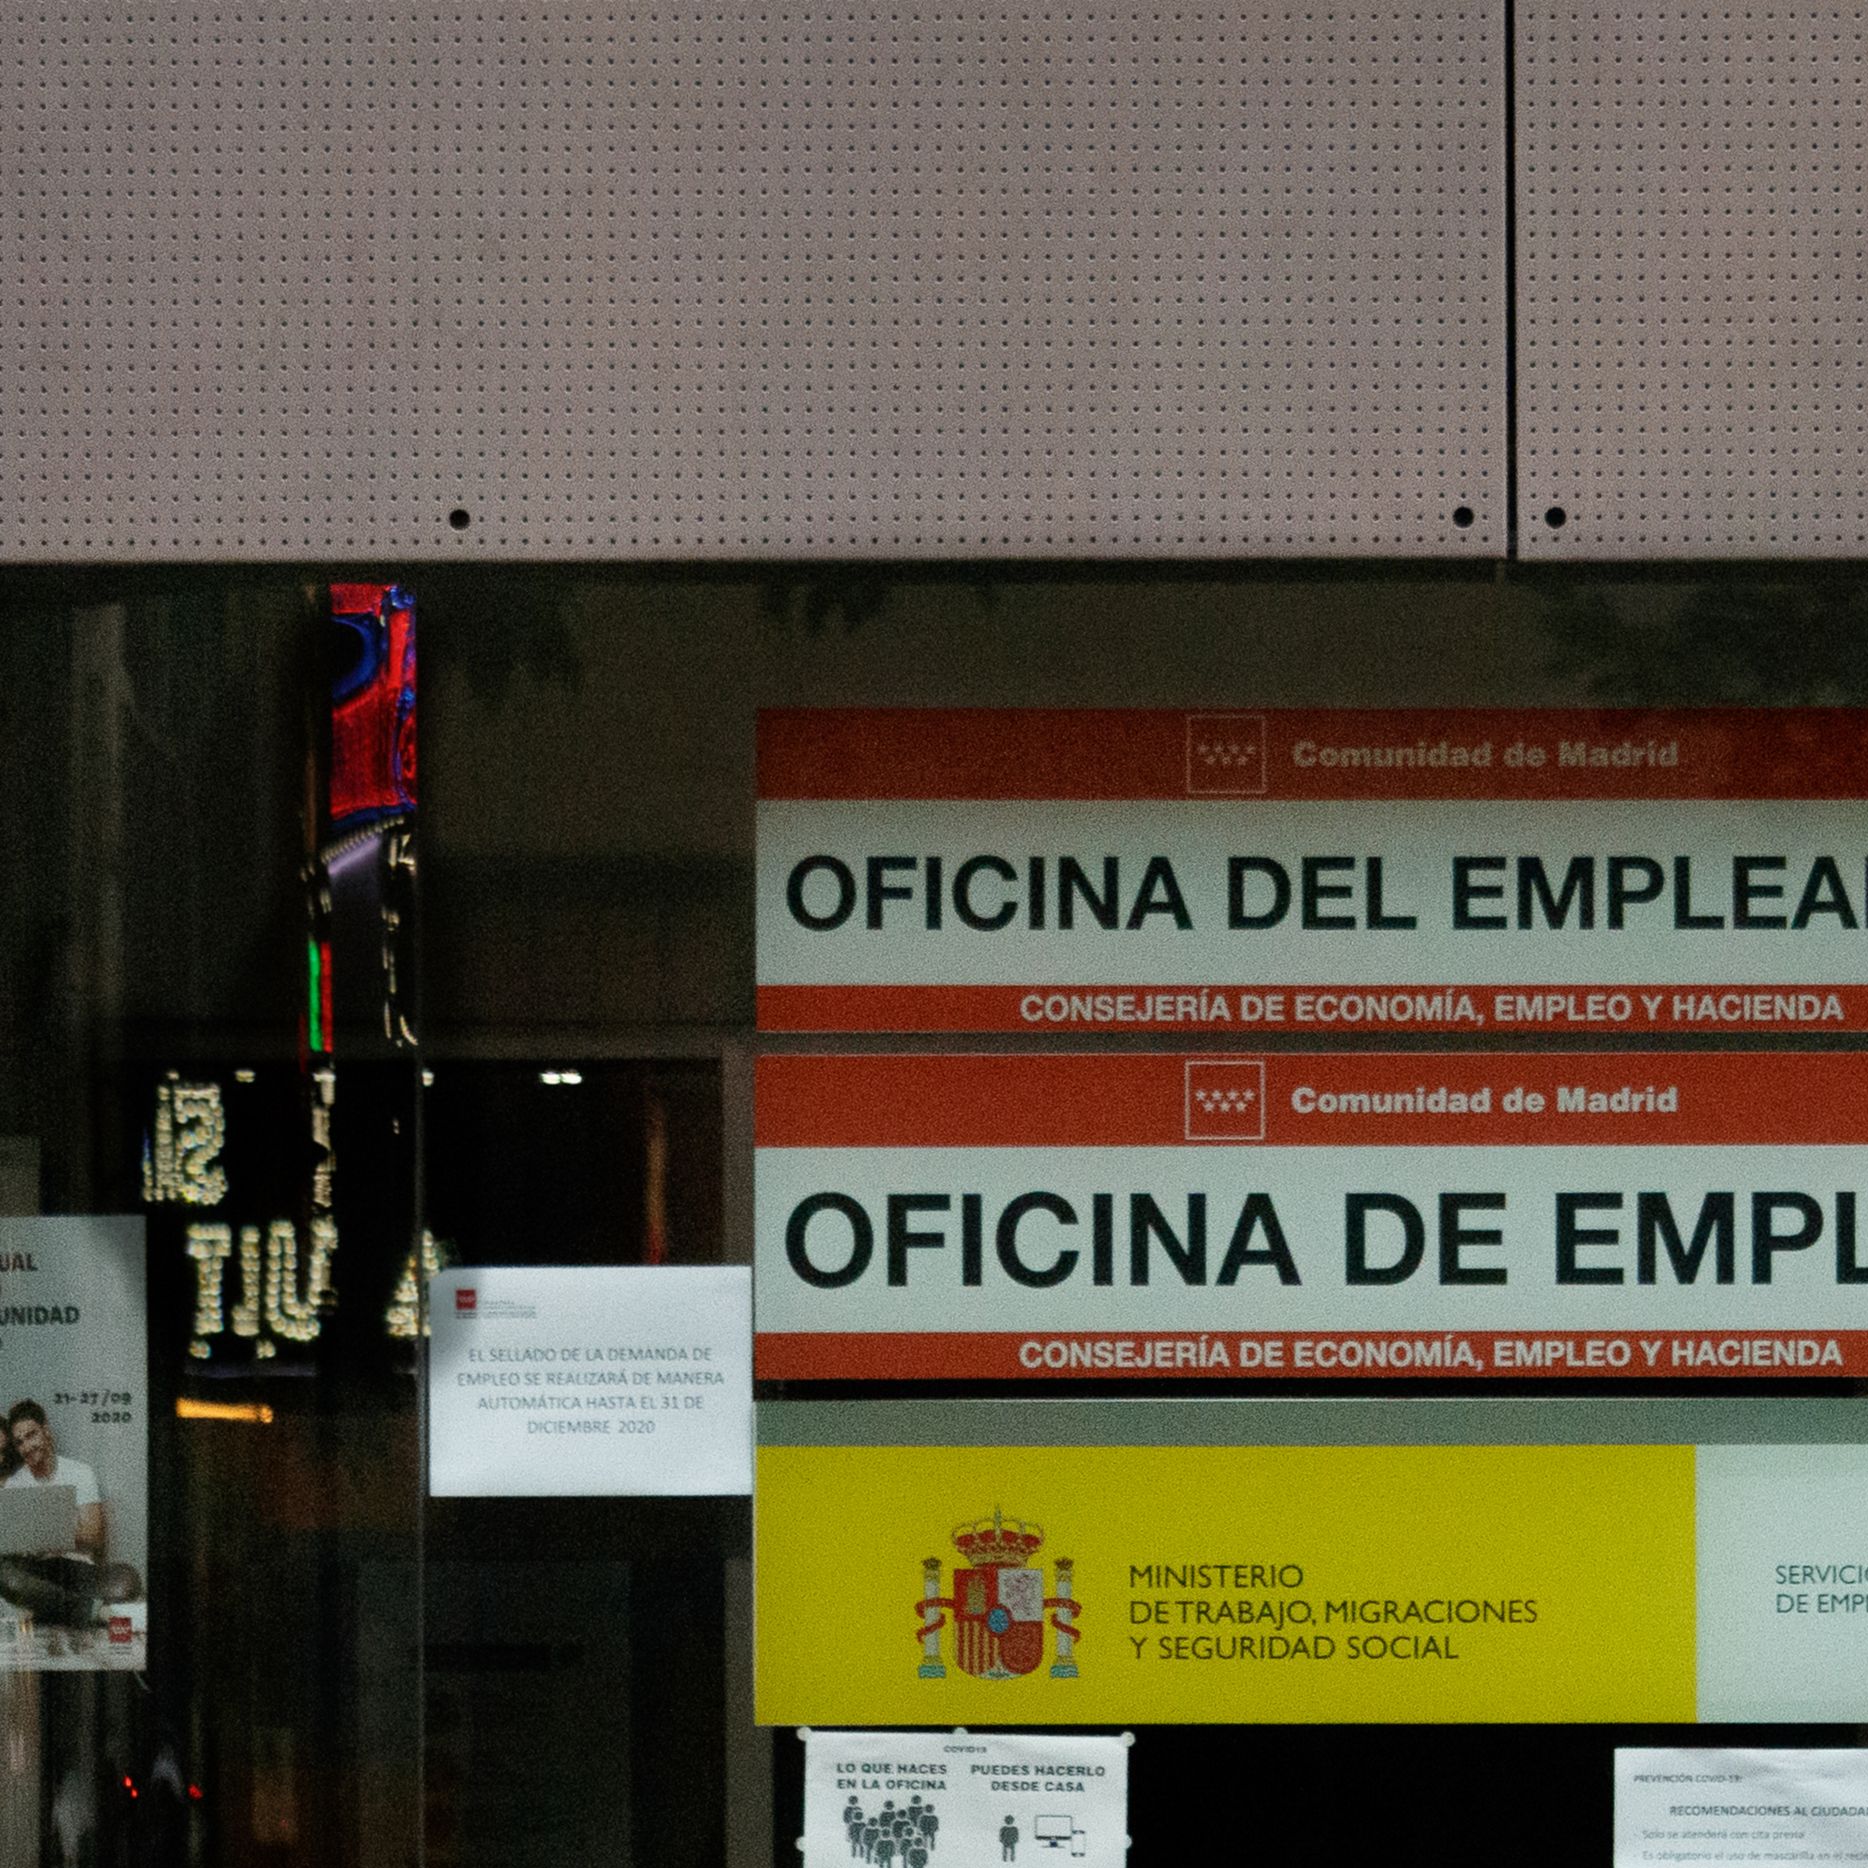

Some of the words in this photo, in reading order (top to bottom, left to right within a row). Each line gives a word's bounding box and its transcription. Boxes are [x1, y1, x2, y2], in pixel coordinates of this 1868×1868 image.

[1292, 741, 1492, 767] Comunidad
[1504, 741, 1546, 767] de
[1558, 741, 1679, 767] Madrid
[786, 855, 1190, 929] OFICINA
[1228, 856, 1414, 928] DEL
[1020, 994, 1231, 1021] CONSEJERÍA
[1241, 995, 1284, 1021] DE
[1295, 991, 1484, 1021] ECONOMÍA,
[1495, 994, 1632, 1021] EMPLEO
[1642, 995, 1662, 1020] Y
[1673, 994, 1843, 1021] HACIENDA
[1291, 1087, 1491, 1113] Comunidad
[1502, 1087, 1545, 1113] de
[1557, 1086, 1678, 1112] Madrid
[786, 1193, 1297, 1287] OFICINA
[1346, 1193, 1505, 1284] DE
[467, 1348, 483, 1361] EL
[489, 1349, 557, 1361] SELLADO
[560, 1348, 580, 1361] DE
[585, 1349, 604, 1361] LA
[607, 1348, 688, 1360] DEMANDA
[692, 1348, 711, 1360] DE
[1019, 1340, 1230, 1368] CONSEJERÍA
[1239, 1340, 1283, 1367] DE
[1294, 1340, 1483, 1368] ECONOMÍA,
[1493, 1339, 1631, 1367] EMPLEO
[1640, 1340, 1662, 1366] Y
[1671, 1339, 1843, 1366] HACIENDA
[456, 1373, 521, 1385] EMPLEO
[524, 1373, 540, 1385] SE
[546, 1372, 628, 1385] REALIZARÁ
[632, 1372, 651, 1385] DE
[656, 1372, 725, 1384] MANERA
[478, 1397, 582, 1408] AUTOMÁTICA
[586, 1396, 636, 1409] HASTA
[640, 1396, 656, 1409] EL
[661, 1396, 679, 1409] 31
[683, 1396, 703, 1409] DE
[90, 1412, 133, 1423] 2020
[527, 1421, 610, 1433] DICIEMBRE
[618, 1420, 656, 1433] 2020
[1130, 1564, 1303, 1588] MINISTERIO
[1777, 1594, 1807, 1613] DE
[1130, 1600, 1168, 1624] DE
[1176, 1600, 1316, 1630] TRABAJO,
[1325, 1600, 1537, 1623] MIGRACIONES
[1130, 1637, 1147, 1659] Y
[1159, 1636, 1336, 1660] SEGURIDAD
[1347, 1636, 1458, 1659] SOCIAL
[836, 1763, 857, 1773] LO
[860, 1763, 891, 1773] QUE
[897, 1764, 947, 1774] HACES
[970, 1765, 1030, 1775] PUEDES
[1034, 1766, 1105, 1776] HACERLO
[837, 1779, 857, 1789] EN
[861, 1780, 880, 1789] LA
[885, 1780, 946, 1789] OFICINA
[1633, 1775, 1693, 1783] PREVENCIÓN
[991, 1781, 1039, 1791] DESDE
[1044, 1782, 1085, 1791] CASA
[1669, 1806, 1791, 1815] RECOMENDACIONES
[1793, 1807, 1808, 1816] AL
[1751, 1831, 1771, 1840] cita
[1655, 1850, 1712, 1862] obligatorio
[1747, 1851, 1761, 1860] de
